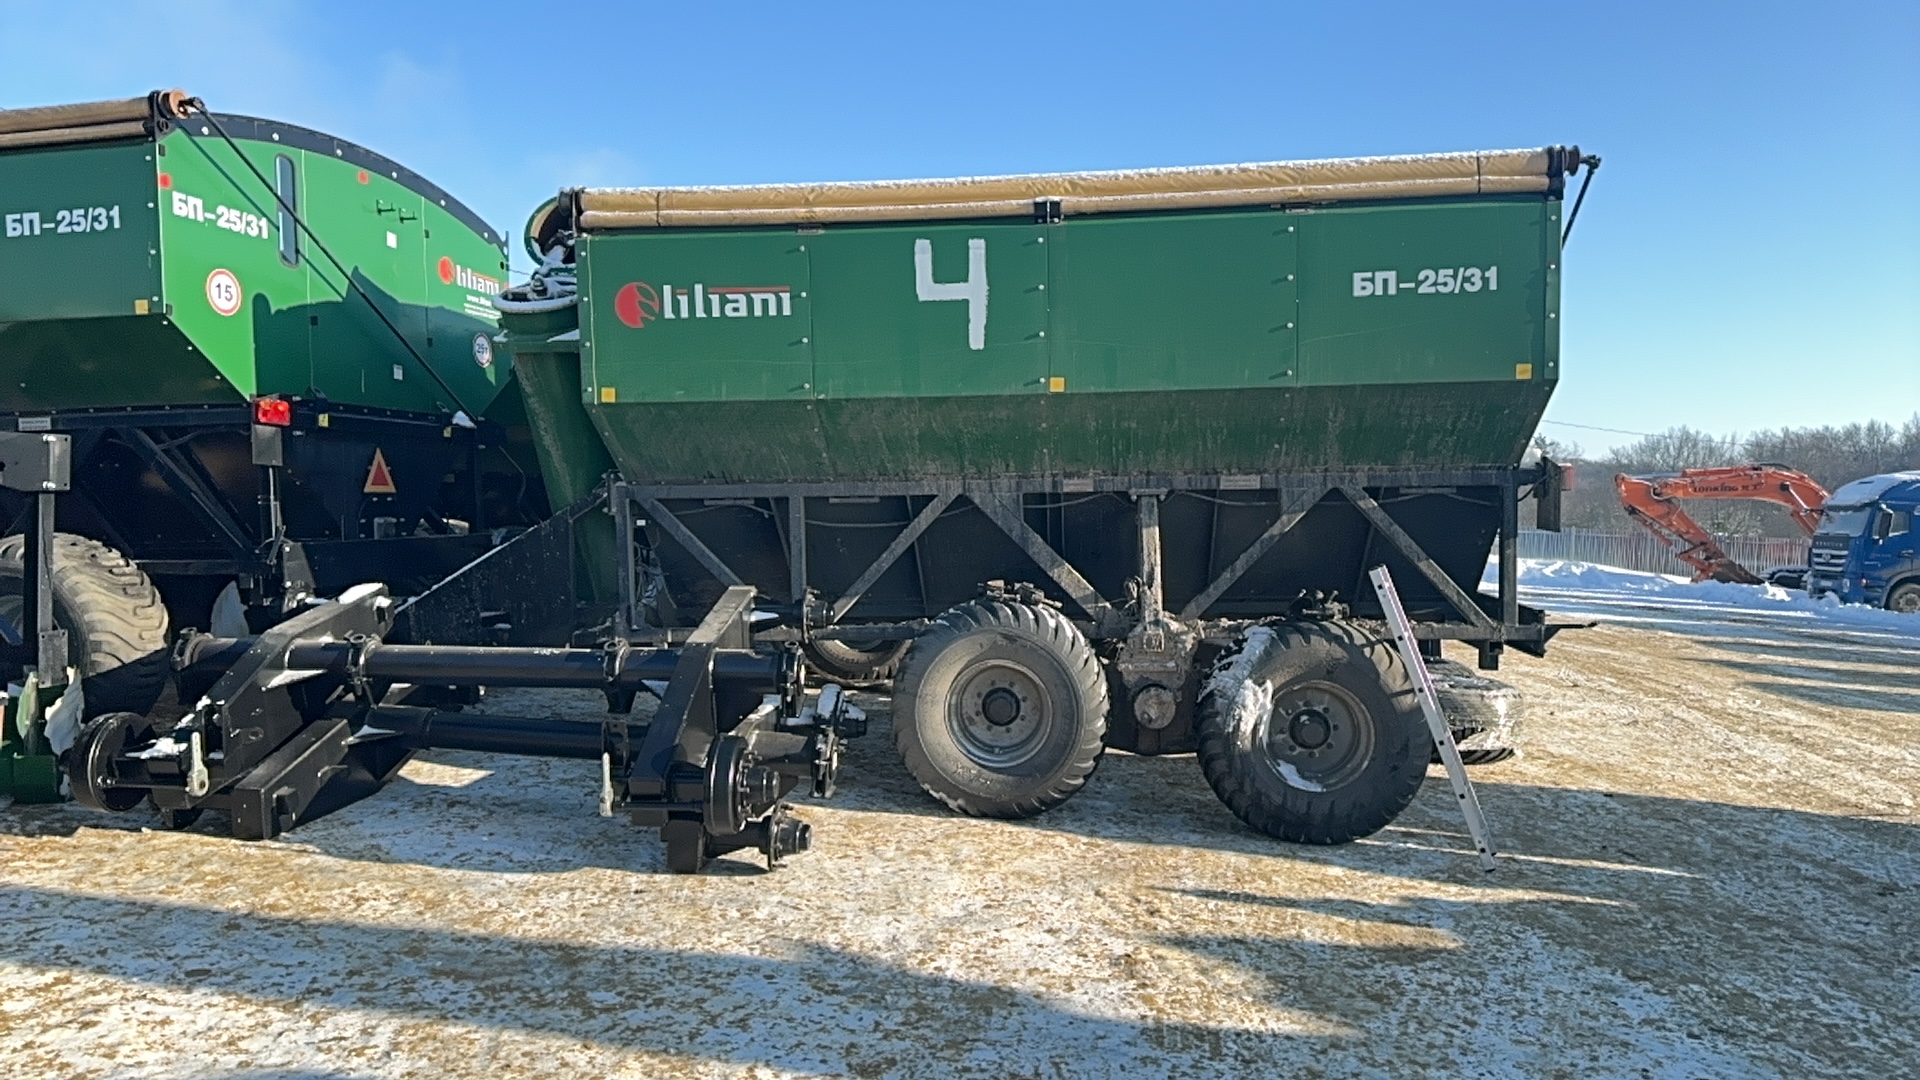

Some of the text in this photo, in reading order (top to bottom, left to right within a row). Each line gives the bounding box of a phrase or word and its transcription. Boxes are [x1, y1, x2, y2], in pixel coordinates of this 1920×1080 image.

[5, 205, 121, 238] БП-25/31
[172, 191, 269, 240] БП-25/31
[215, 282, 234, 303] 15
[456, 264, 500, 295] liliani
[914, 238, 990, 350] 4
[1353, 265, 1498, 297] БП-25/31
[662, 283, 792, 319] liliani
